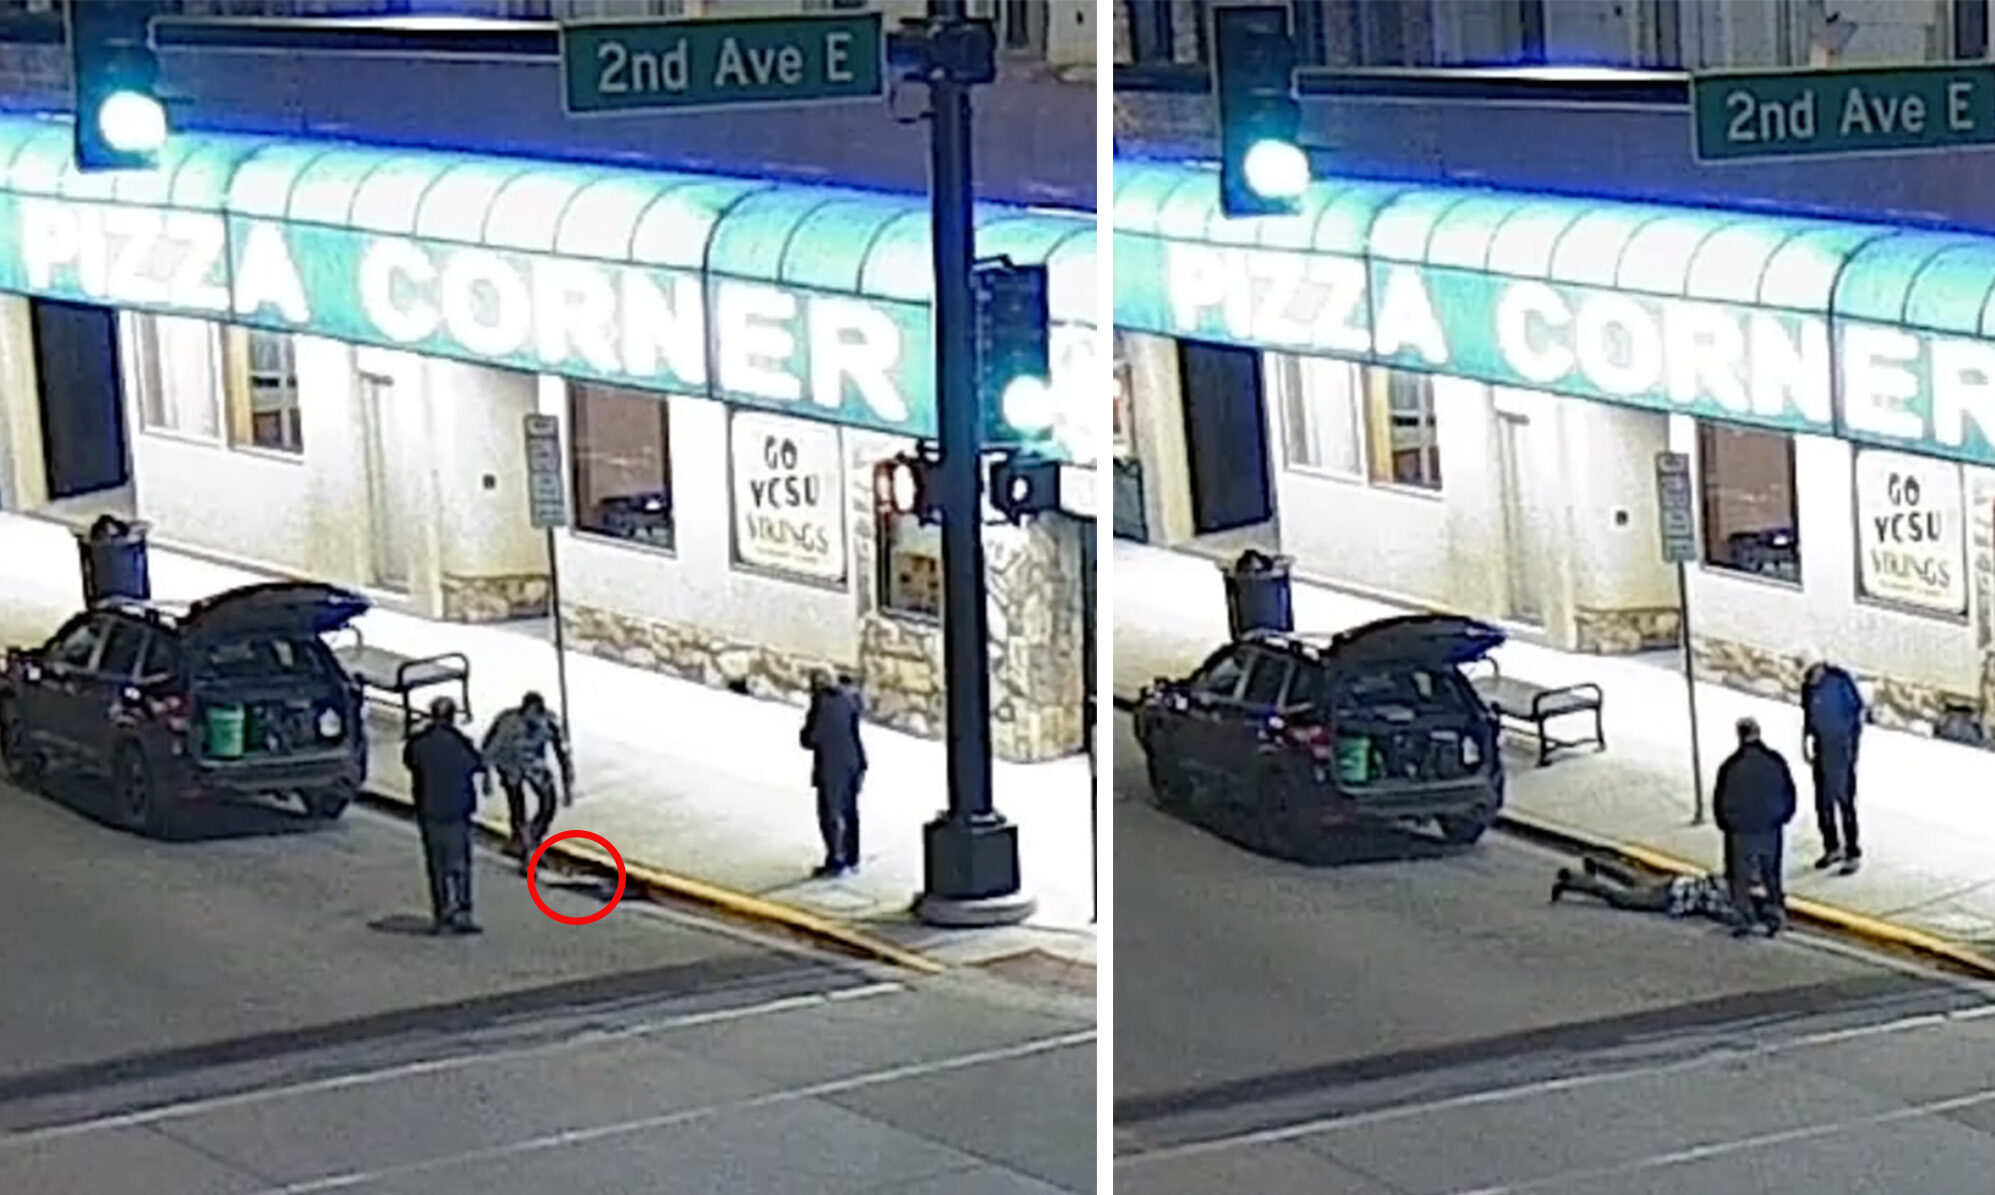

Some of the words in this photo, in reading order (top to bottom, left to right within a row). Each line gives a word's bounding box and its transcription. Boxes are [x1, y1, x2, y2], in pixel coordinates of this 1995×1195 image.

[597, 41, 688, 93] 2nd
[714, 38, 803, 88] Ave
[826, 33, 853, 80] E
[1726, 88, 1816, 141] 2nd
[1840, 86, 1926, 135] Ave
[1948, 82, 1975, 131] E
[22, 199, 312, 322] PIZZA
[358, 236, 909, 422] CORNER
[1166, 243, 1450, 364] PIZZA
[1495, 279, 1994, 448] CORNER
[764, 434, 798, 470] GO
[1888, 472, 1920, 506] GO
